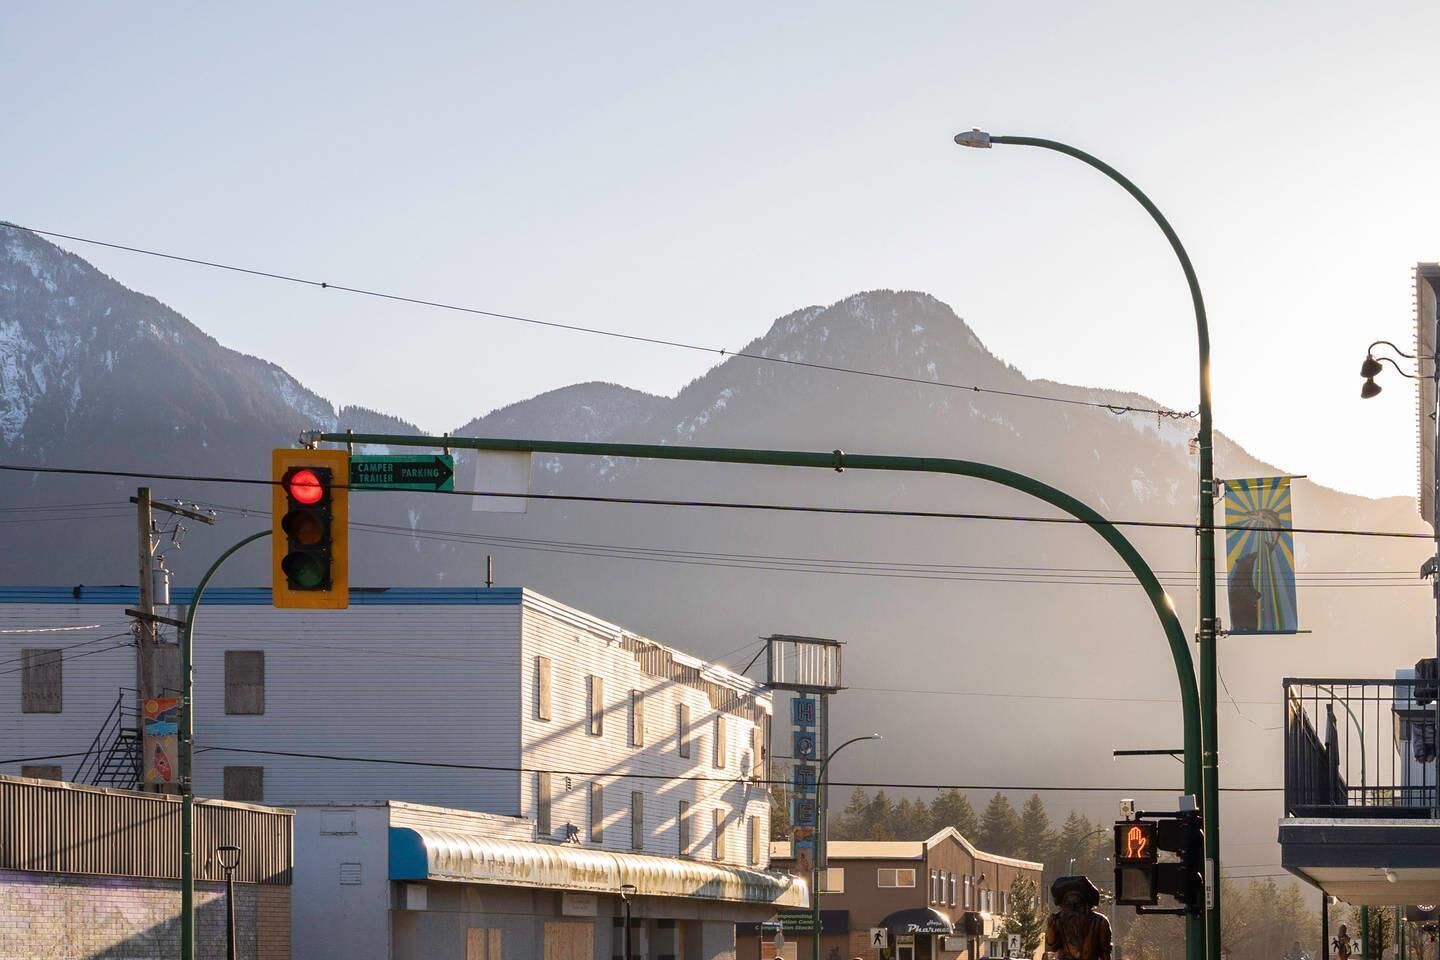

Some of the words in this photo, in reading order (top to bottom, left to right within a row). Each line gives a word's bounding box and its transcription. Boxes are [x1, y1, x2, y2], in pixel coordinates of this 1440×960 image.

[358, 463, 392, 472] CAMPER
[360, 473, 392, 482] TRAILER
[401, 468, 439, 478] PARKING
[907, 923, 950, 933] Pharma
